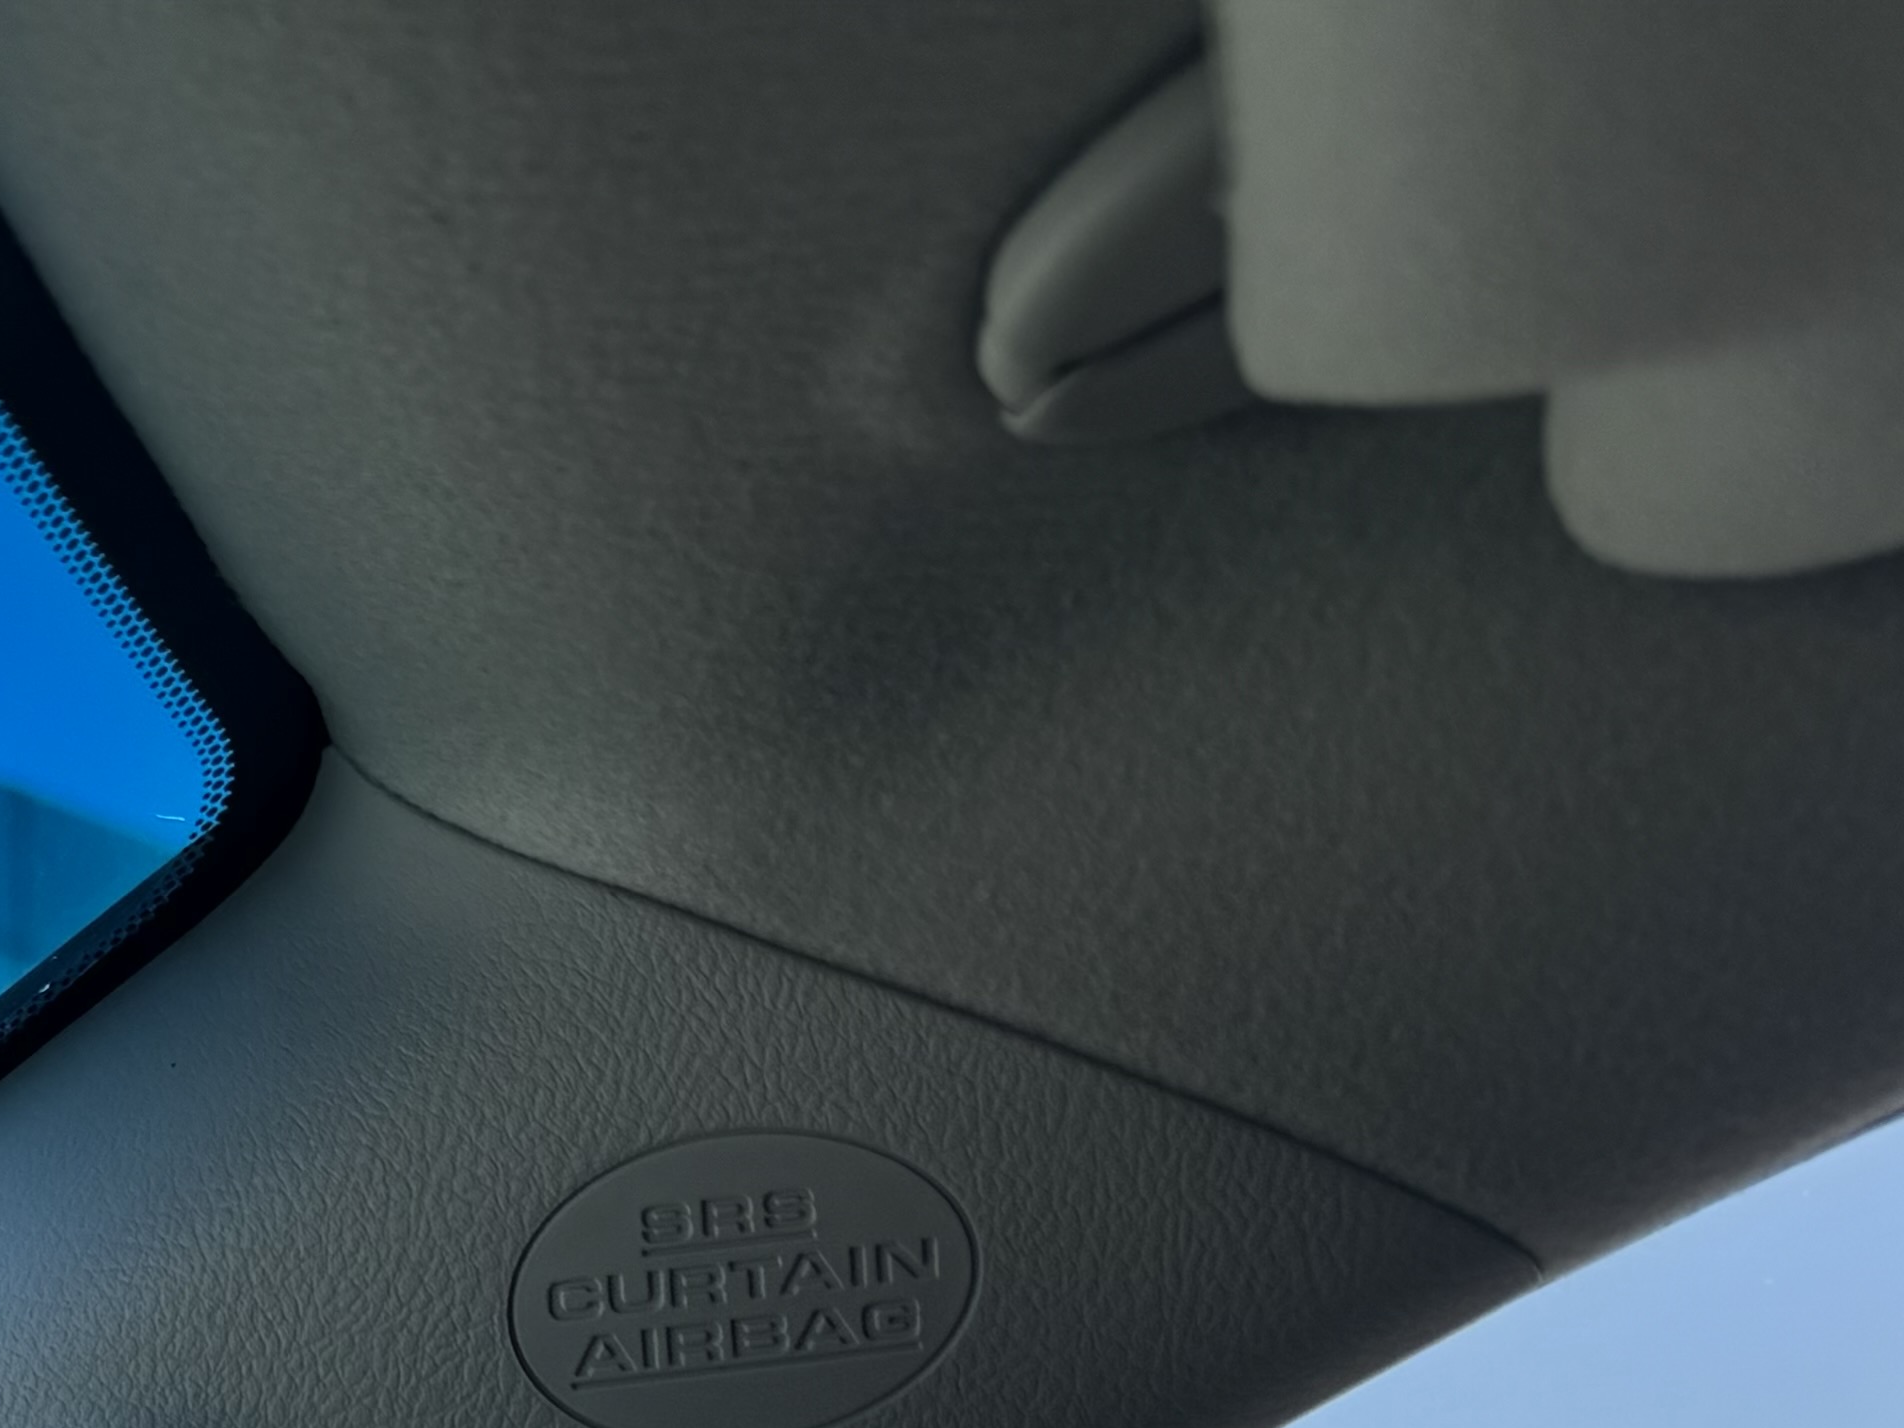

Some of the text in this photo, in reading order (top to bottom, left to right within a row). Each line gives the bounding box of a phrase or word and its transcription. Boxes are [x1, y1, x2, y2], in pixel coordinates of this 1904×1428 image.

[640, 1186, 818, 1245] SRS
[545, 1236, 941, 1322] CURTAIN
[573, 1296, 924, 1379] AIRBAG
